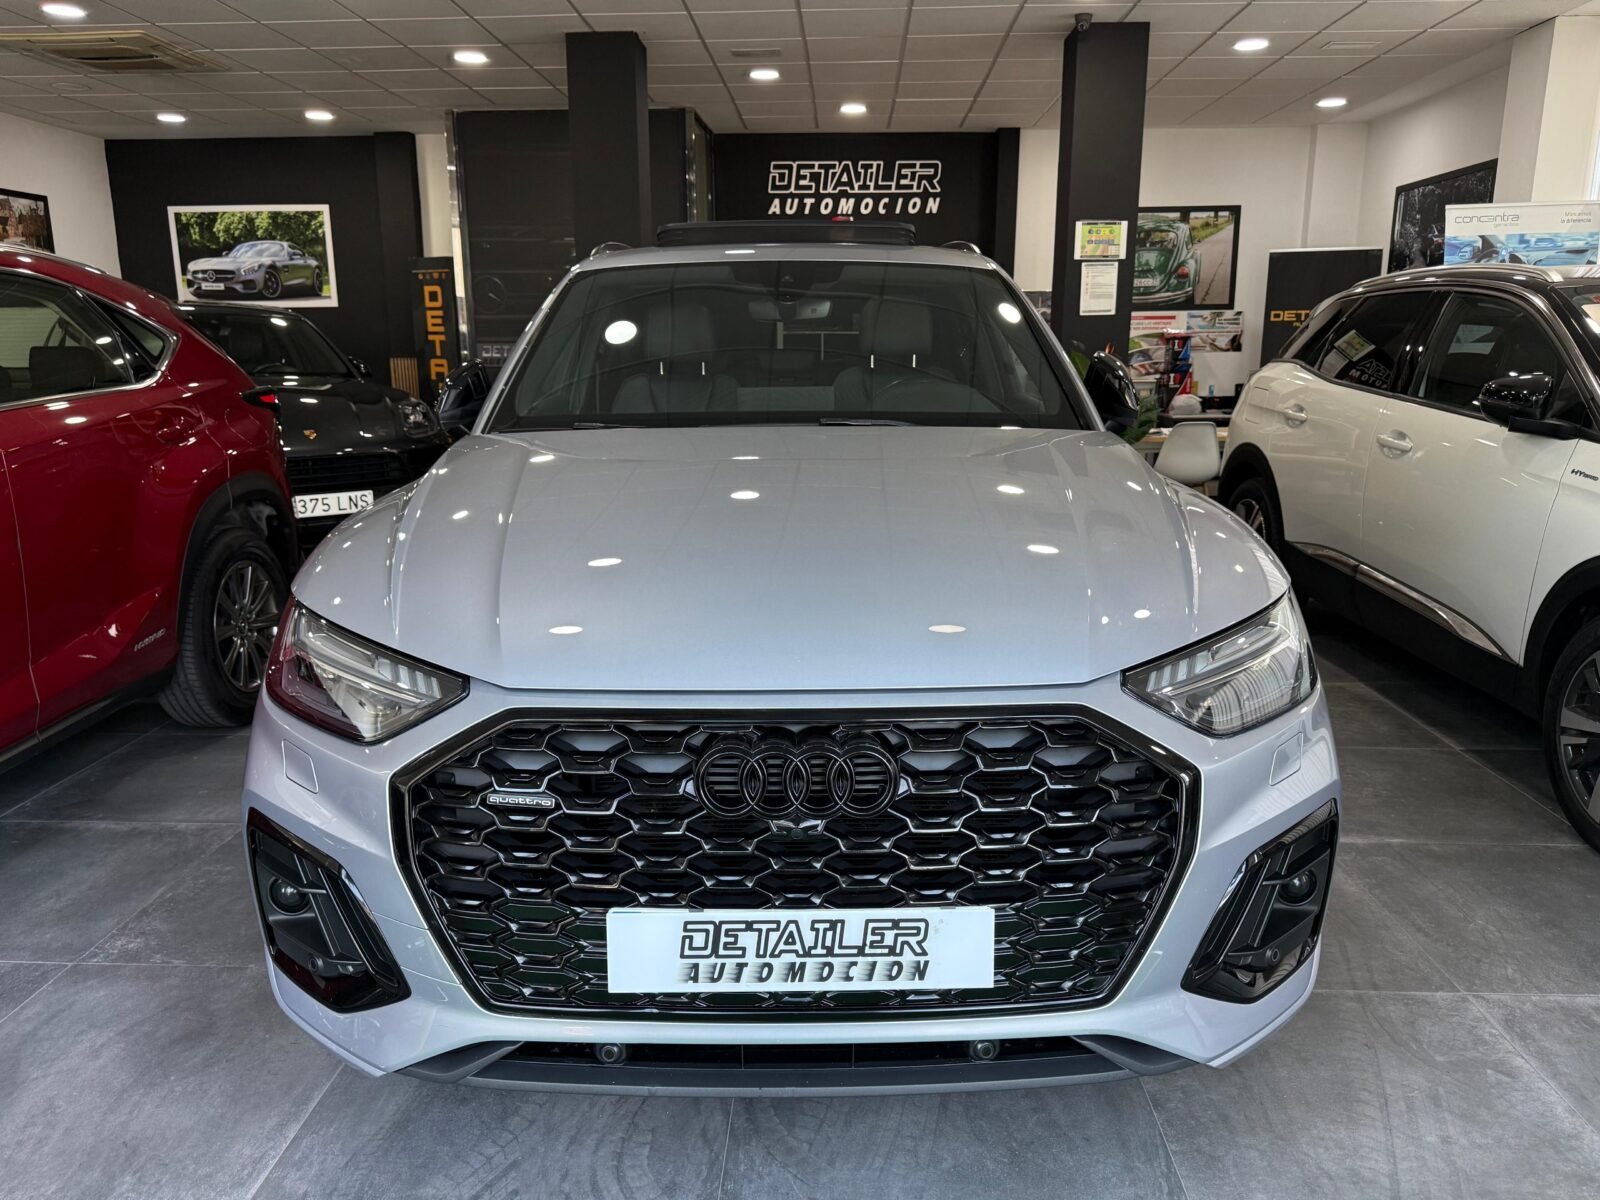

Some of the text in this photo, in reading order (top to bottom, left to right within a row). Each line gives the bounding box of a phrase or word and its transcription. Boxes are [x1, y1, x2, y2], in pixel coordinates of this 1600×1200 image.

[767, 160, 942, 194] DETAILER
[767, 197, 941, 215] AUTOMOCION
[1454, 212, 1520, 224] concentra
[423, 285, 449, 388] DETA
[337, 494, 369, 511] LNS
[489, 796, 552, 806] quattro
[679, 917, 930, 959] DETAILER
[677, 959, 930, 984] AUTOMOCION
